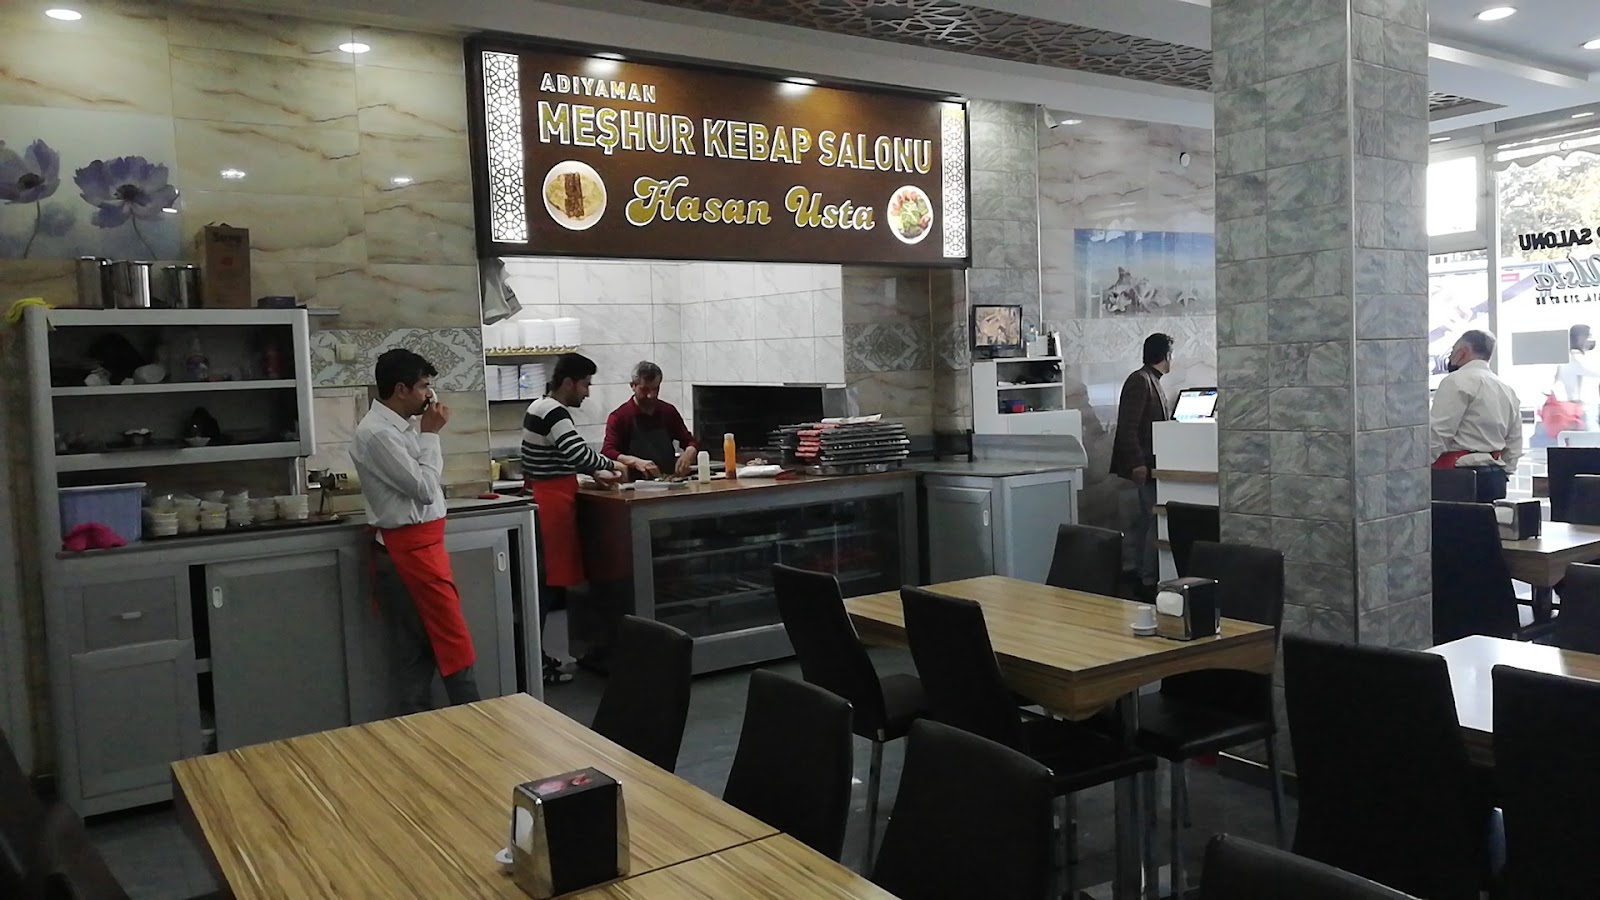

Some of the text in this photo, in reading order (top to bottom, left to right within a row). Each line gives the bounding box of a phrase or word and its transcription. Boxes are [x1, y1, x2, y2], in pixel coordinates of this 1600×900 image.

[540, 73, 656, 103] ADIYAMAN
[537, 101, 932, 174] MEŞHUR KEBAP SALONU
[625, 176, 876, 230] Hasan Usta
